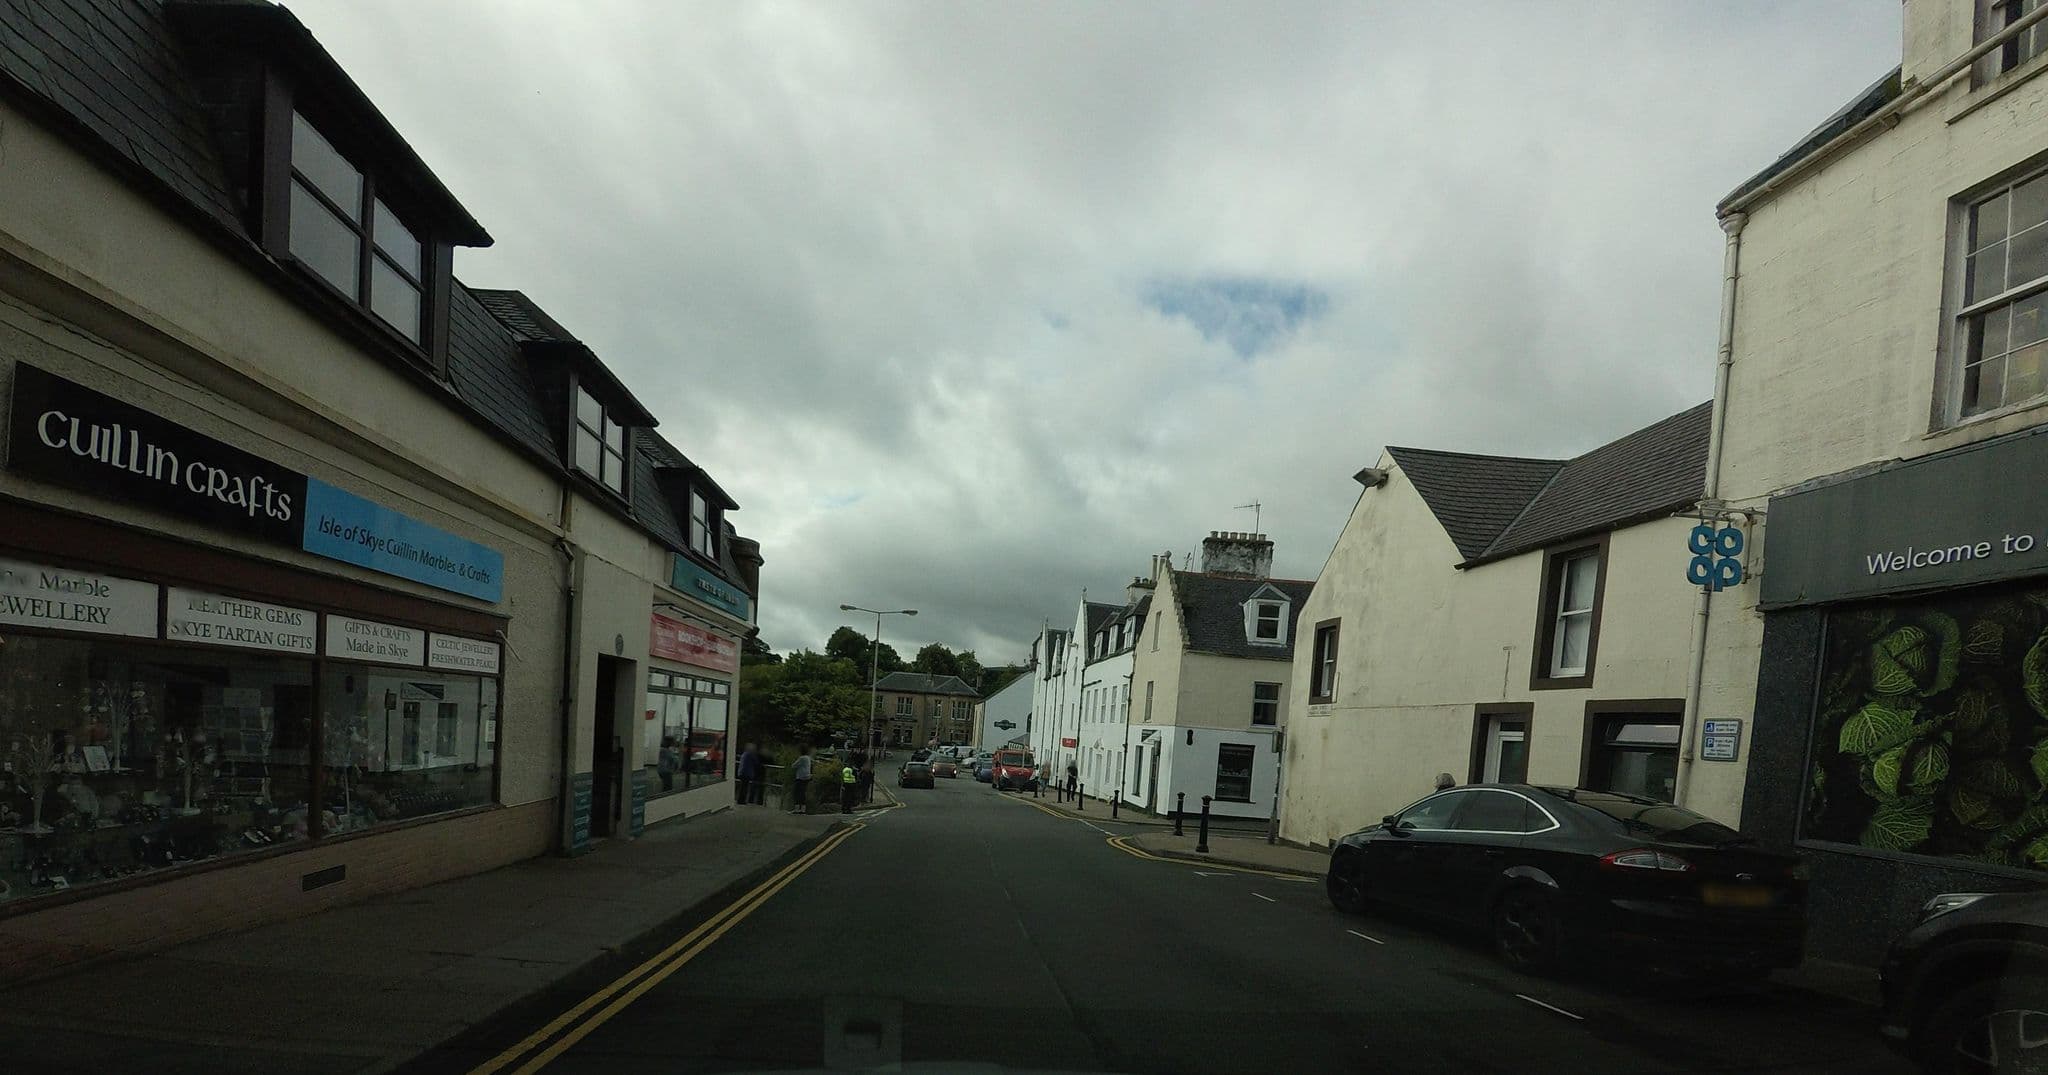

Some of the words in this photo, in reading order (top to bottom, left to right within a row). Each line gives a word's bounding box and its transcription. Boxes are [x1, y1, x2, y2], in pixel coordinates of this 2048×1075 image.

[318, 514, 341, 538] Isle
[343, 525, 360, 542] of
[358, 528, 385, 553] Skye
[386, 538, 418, 562] Cuillin
[418, 550, 456, 575] Marbles
[458, 562, 465, 574] &
[466, 564, 491, 585] Crafts
[1866, 539, 1993, 576] Welcome
[2001, 532, 2034, 556] to
[39, 570, 111, 598] Marble
[265, 608, 303, 627] GEMS
[215, 624, 274, 645] TARTAN
[276, 633, 313, 650] GIFTS
[344, 621, 372, 636] GIFTS
[372, 627, 381, 638] &
[380, 627, 412, 642] CRAFTS
[345, 636, 375, 654] Made
[376, 641, 386, 656] in
[388, 643, 410, 661] Skye
[431, 652, 476, 667] FRESHWATER
